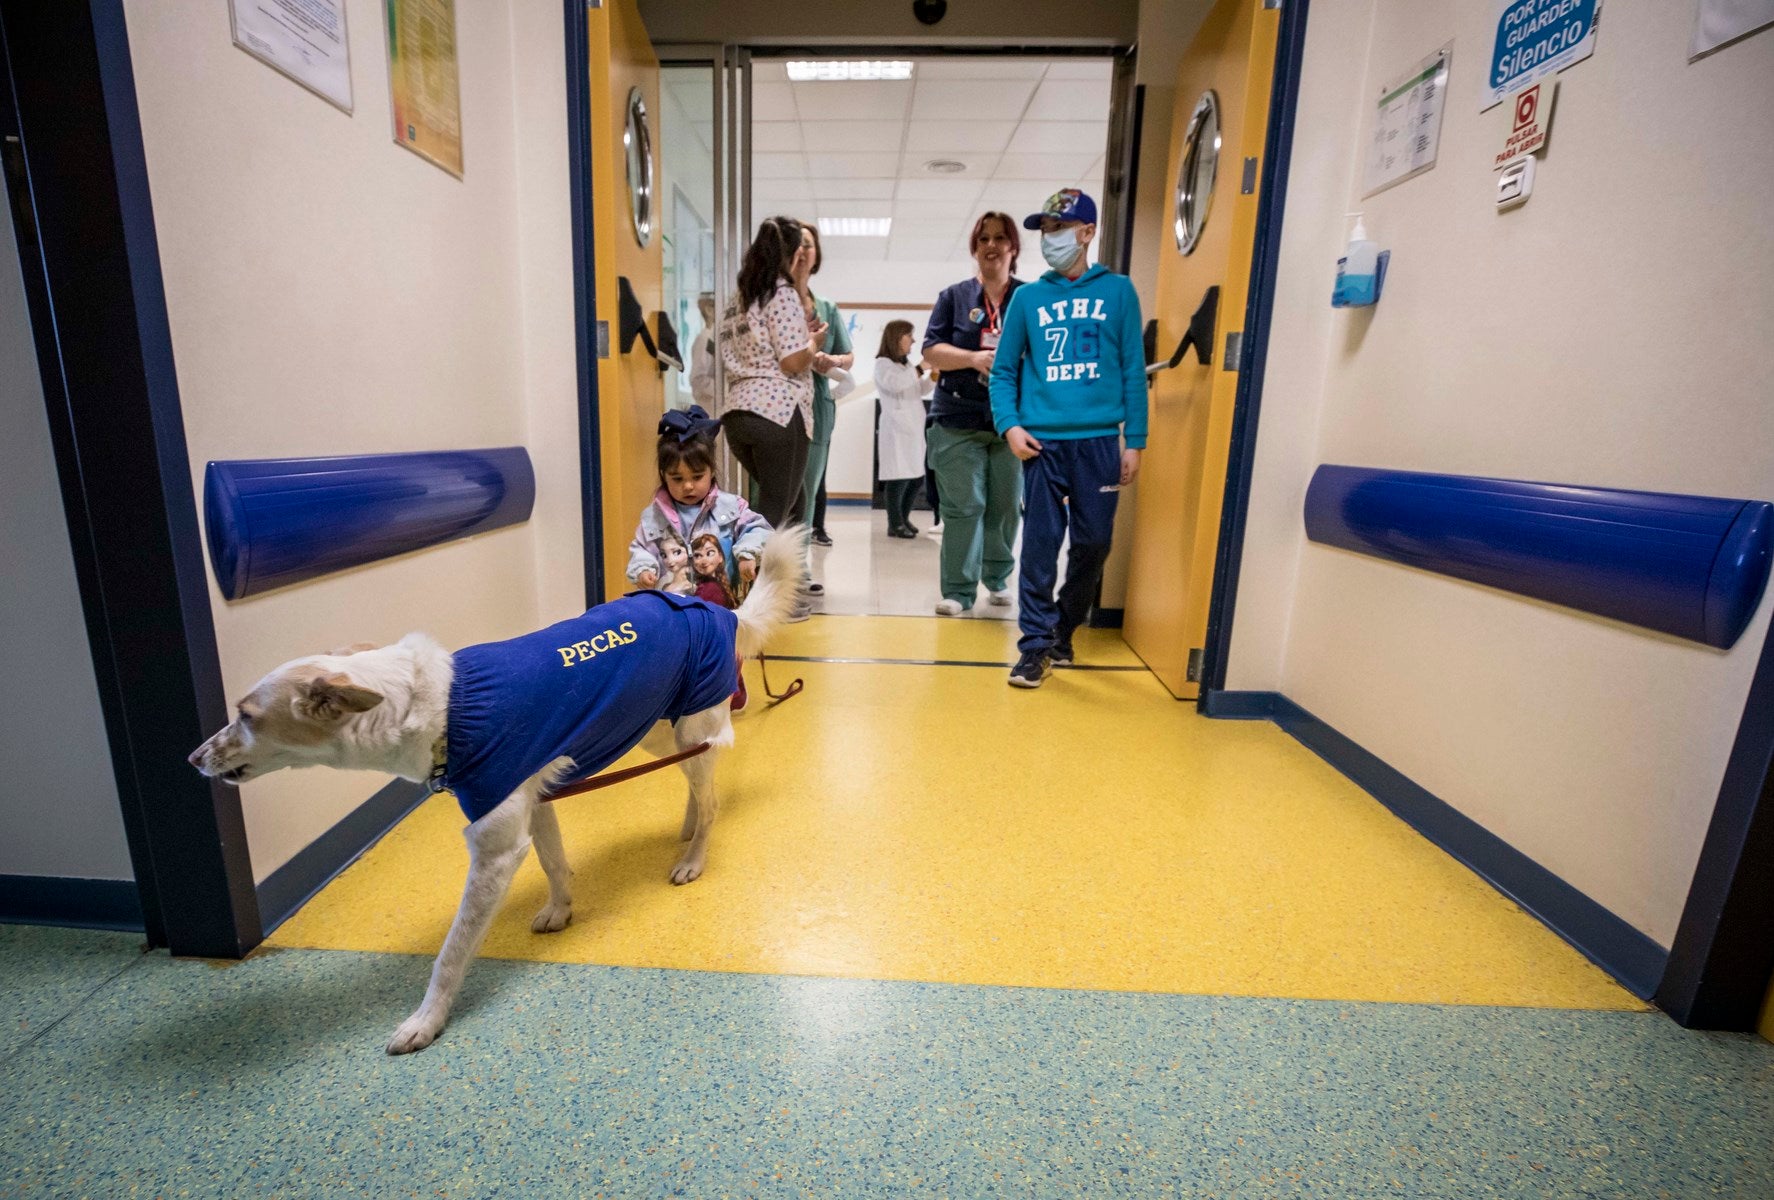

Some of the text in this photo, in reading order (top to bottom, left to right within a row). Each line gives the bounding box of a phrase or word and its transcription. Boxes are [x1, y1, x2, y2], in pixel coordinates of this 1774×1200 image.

[1504, 0, 1536, 31] POR
[1506, 0, 1581, 48] GUARDEN
[1497, 20, 1582, 83] Silencio
[1495, 133, 1544, 164] PARA ABRIR
[1505, 124, 1538, 148] PULSAR
[1037, 298, 1107, 327] ATHL
[1046, 362, 1101, 382] DEPT.
[556, 621, 638, 667] PECAS
